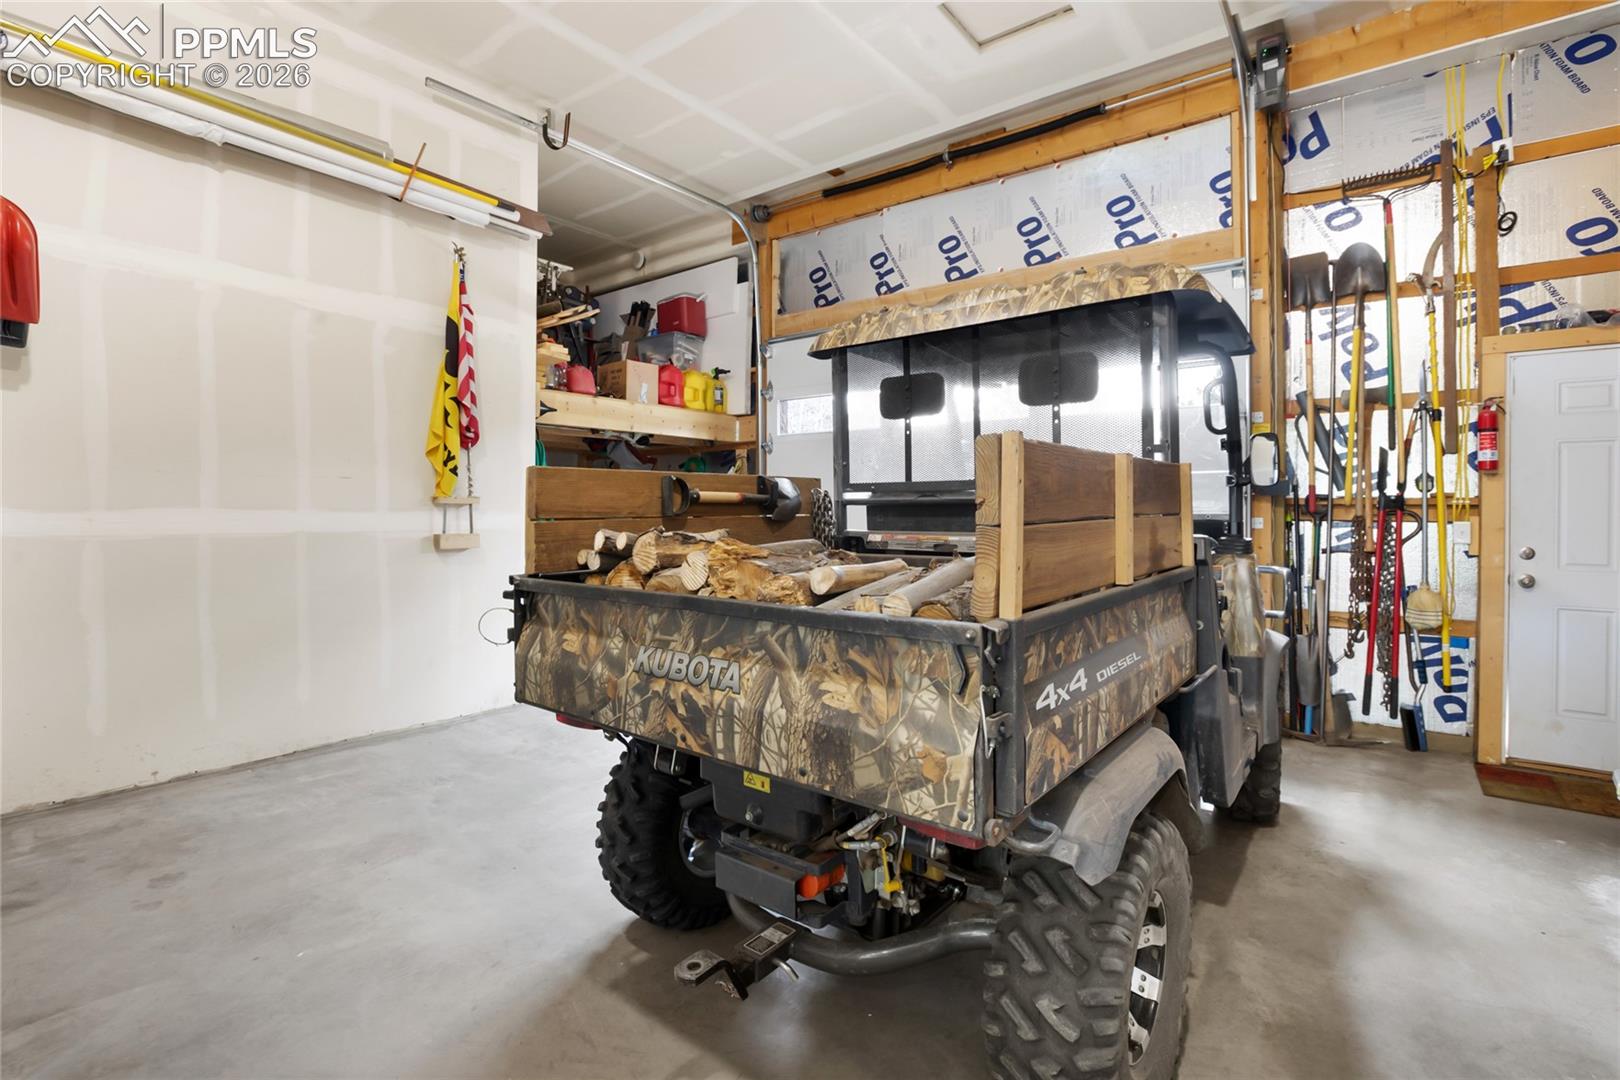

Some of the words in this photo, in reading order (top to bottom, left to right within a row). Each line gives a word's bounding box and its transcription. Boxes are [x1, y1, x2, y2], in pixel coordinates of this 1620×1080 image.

[1567, 72, 1591, 94] BOARD
[1016, 216, 1062, 267] Pro
[1106, 195, 1159, 249] Pro
[869, 252, 904, 296] Pro
[938, 235, 979, 282] Pro
[809, 267, 841, 308] Pro
[634, 645, 741, 695] KUBOTA
[1035, 668, 1088, 710] 4x4
[1096, 652, 1142, 682] DIESEL
